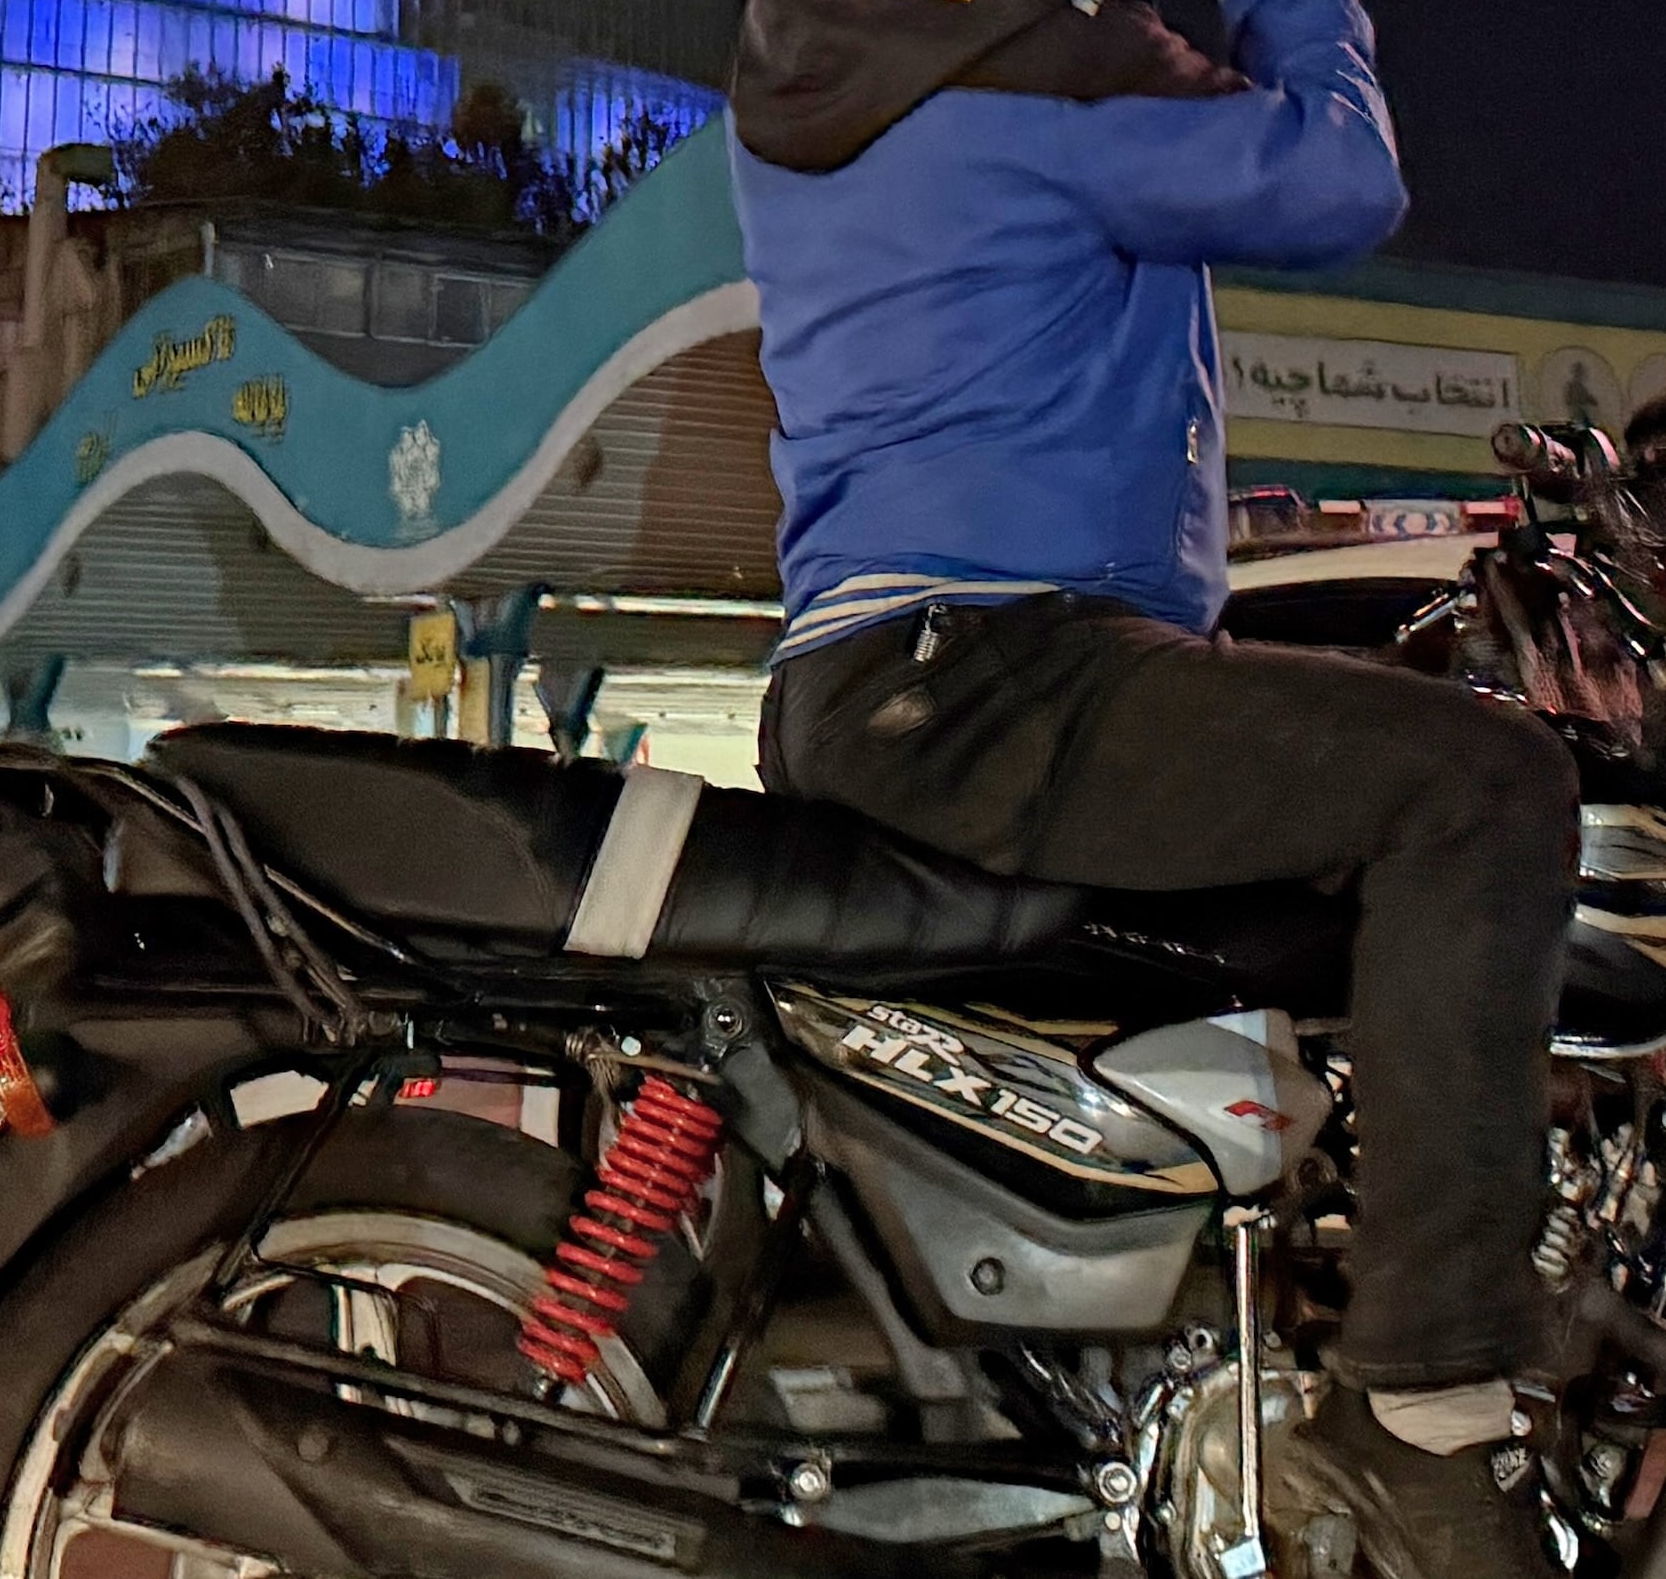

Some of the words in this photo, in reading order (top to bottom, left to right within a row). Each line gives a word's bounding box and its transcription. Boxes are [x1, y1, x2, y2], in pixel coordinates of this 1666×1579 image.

[1316, 358, 1387, 404] شما
[1391, 372, 1511, 417] انتخاب
[841, 1024, 993, 1108] HLX
[990, 1087, 1104, 1155] 150
